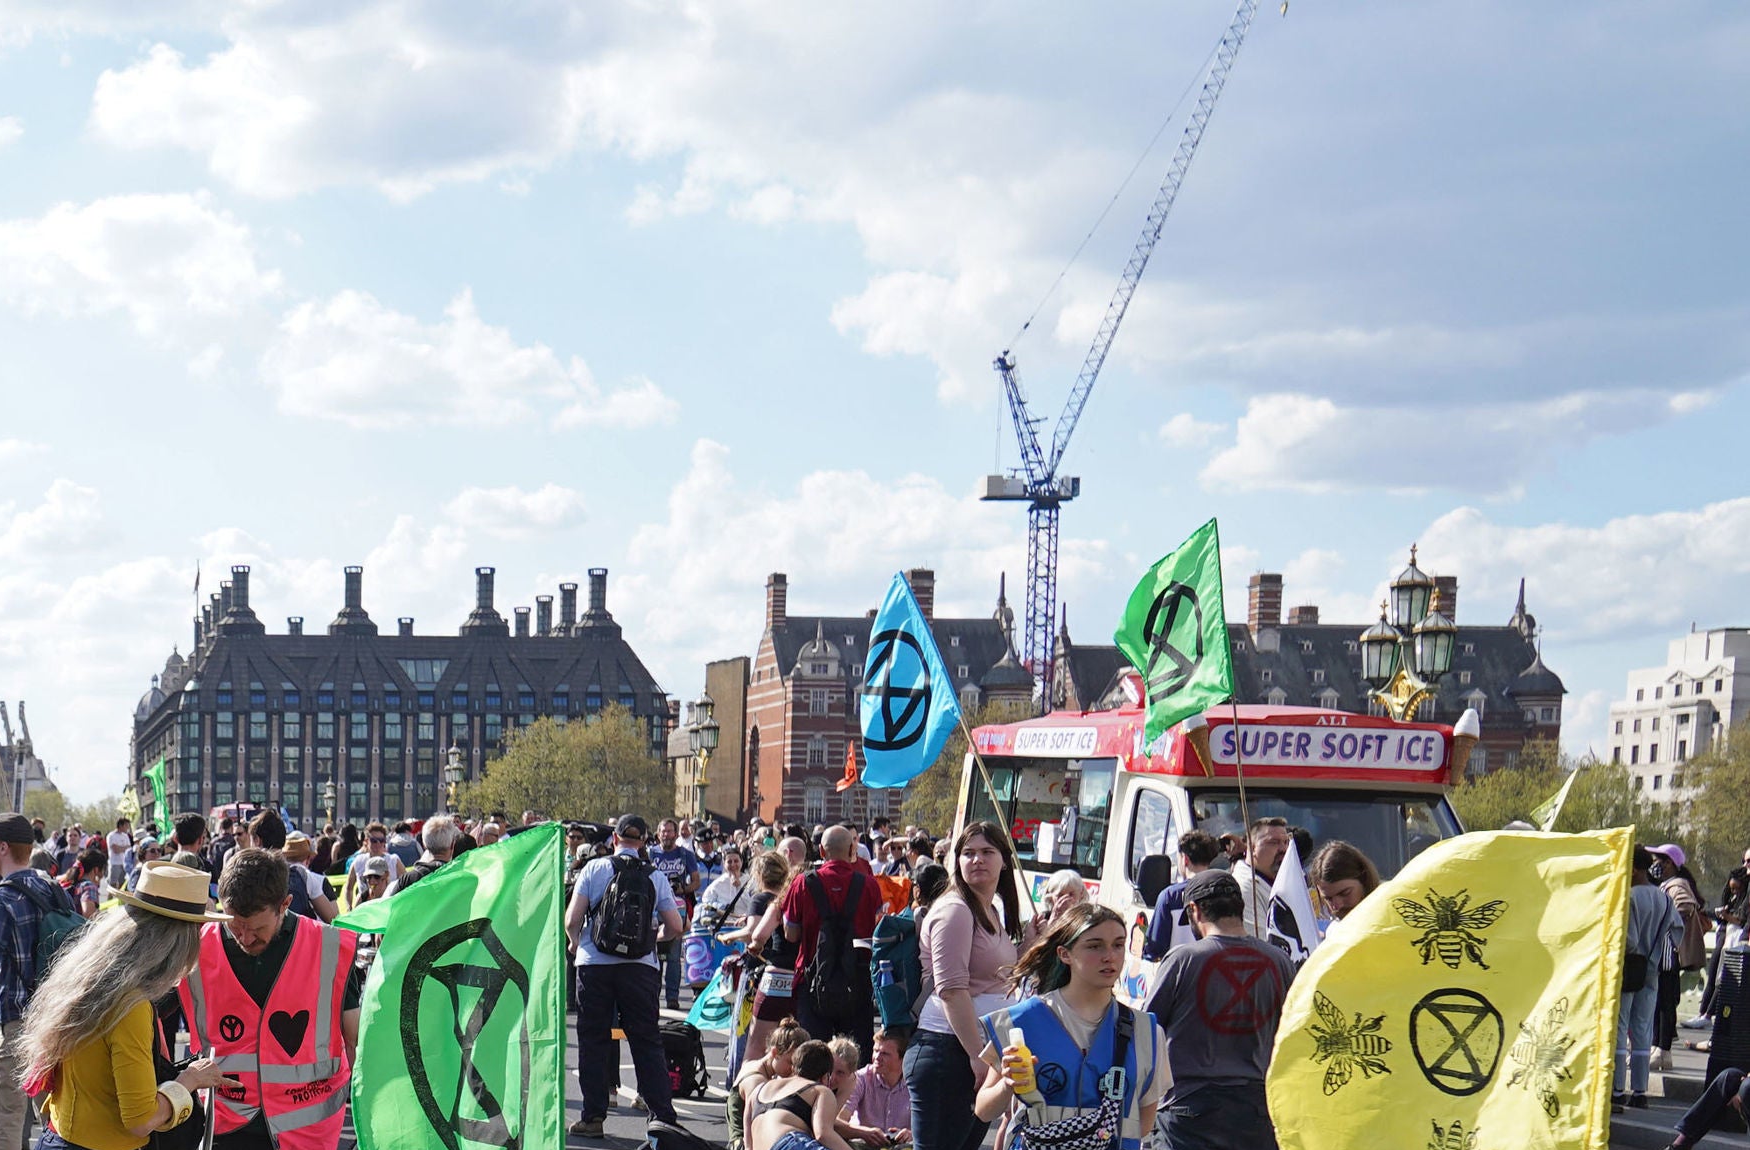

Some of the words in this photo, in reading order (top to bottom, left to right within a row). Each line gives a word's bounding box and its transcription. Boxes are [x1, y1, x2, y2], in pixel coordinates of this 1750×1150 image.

[1315, 715, 1348, 726] ALI
[1018, 732, 1047, 749] SUPER
[1050, 731, 1075, 750] SOFT
[1076, 732, 1095, 750] ICE
[1220, 730, 1312, 760] SUPER
[1319, 732, 1388, 763] SOFT
[1395, 735, 1435, 765] ICE
